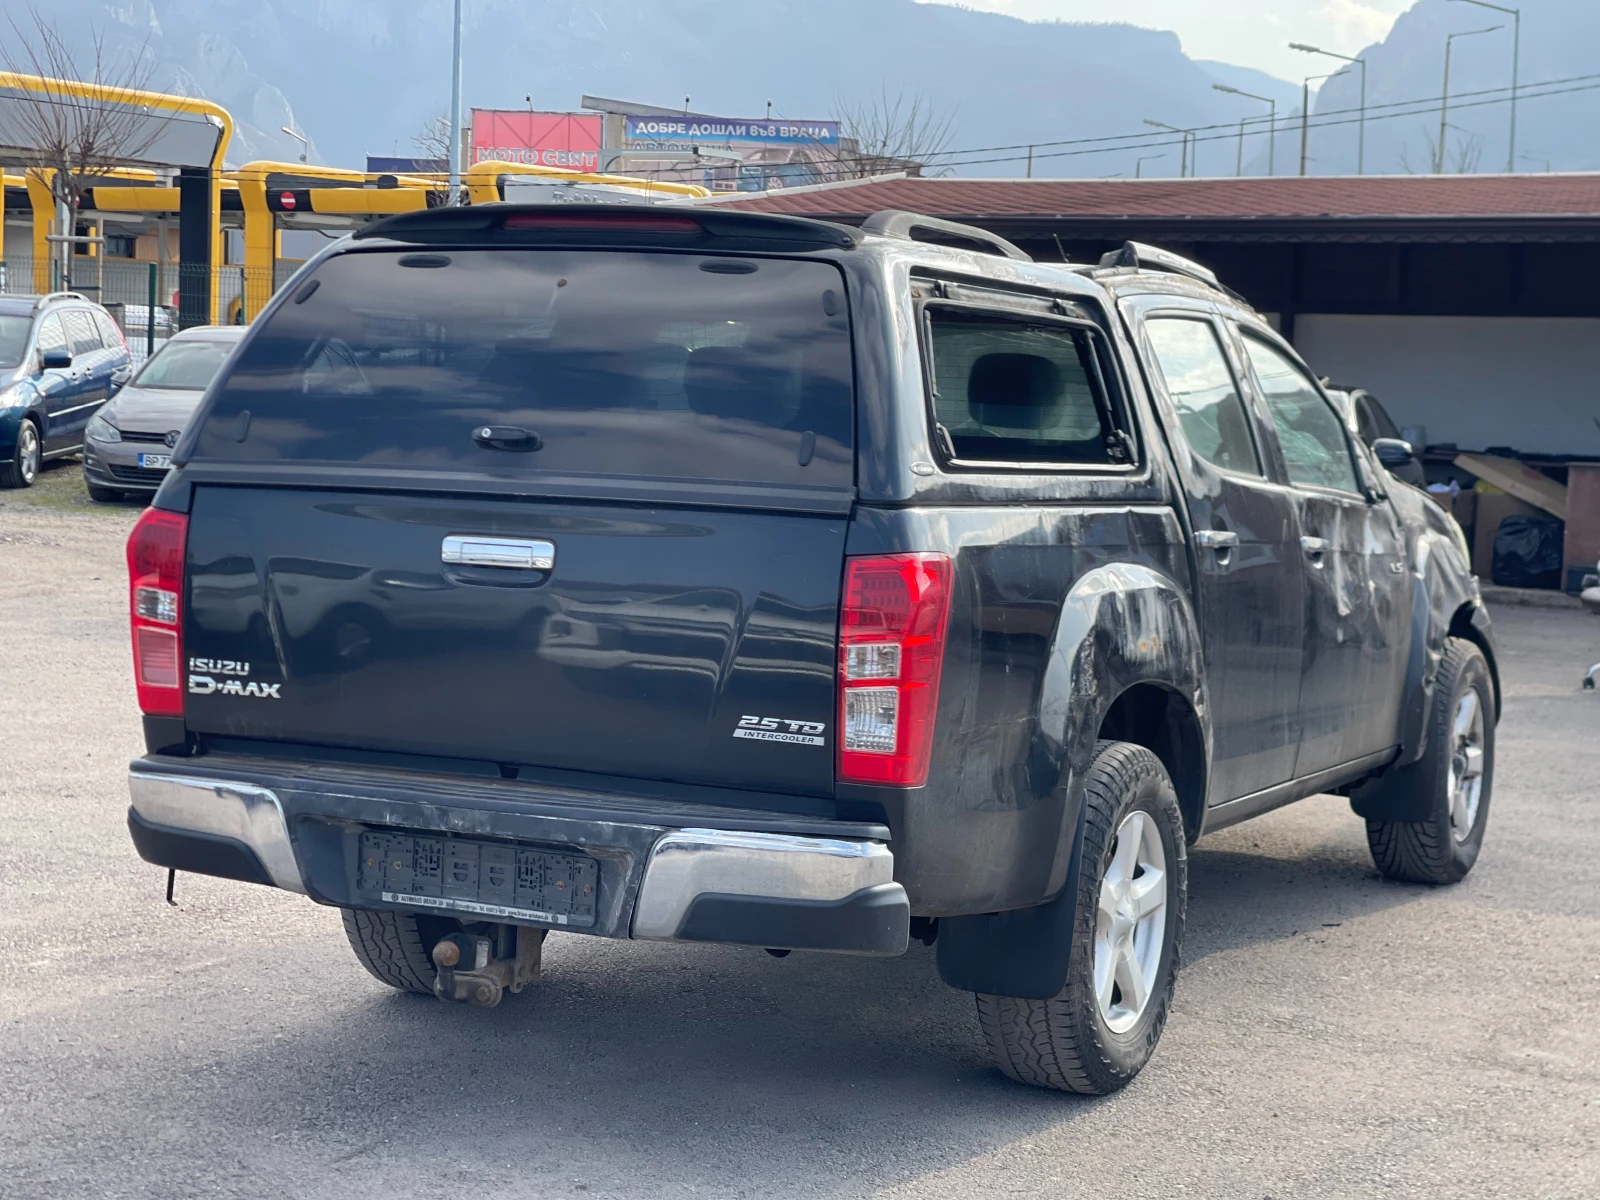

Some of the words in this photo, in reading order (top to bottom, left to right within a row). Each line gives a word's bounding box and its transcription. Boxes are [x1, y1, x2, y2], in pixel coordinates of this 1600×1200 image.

[636, 121, 687, 135] ДОБРЕ
[688, 123, 747, 136] ДОШЛИ
[779, 126, 830, 140] ВРАЦА
[477, 146, 539, 165] МОТО
[542, 148, 598, 167] СВЯТ
[189, 657, 250, 676] ISUZU
[188, 674, 282, 699] D-MAX
[743, 731, 815, 744] INTERCOOLER
